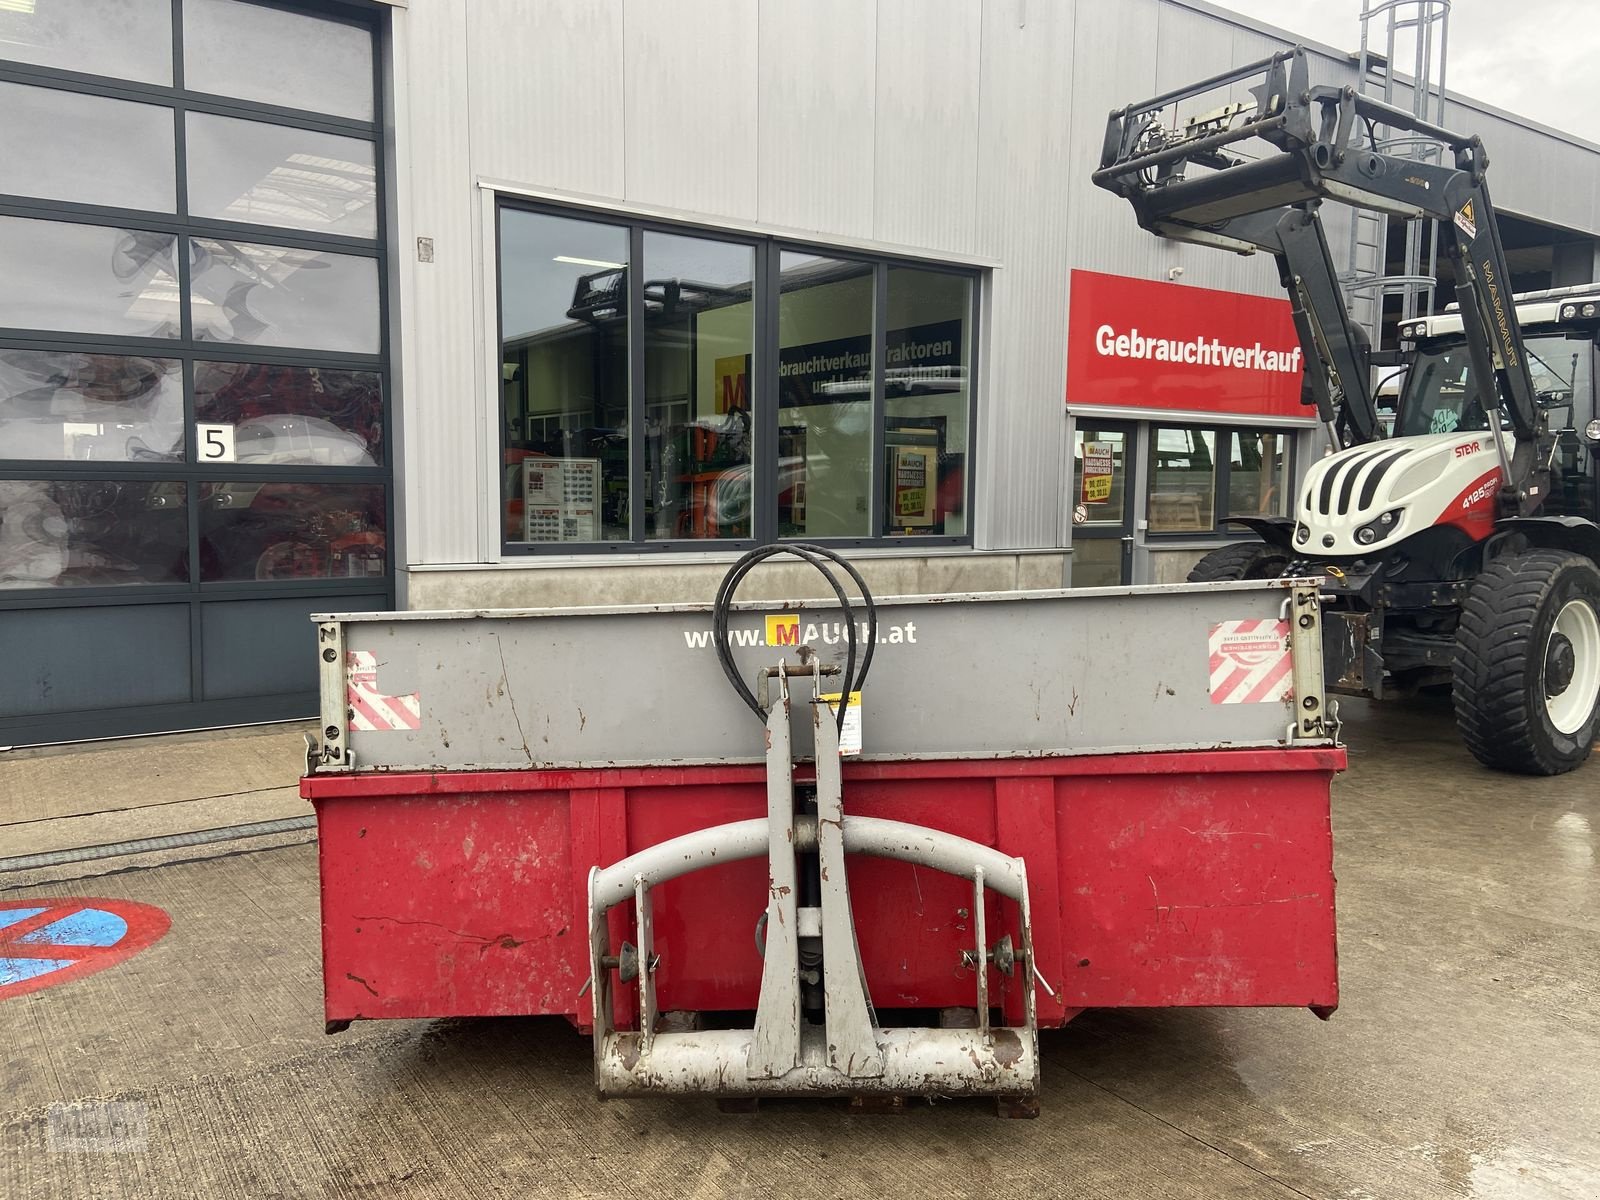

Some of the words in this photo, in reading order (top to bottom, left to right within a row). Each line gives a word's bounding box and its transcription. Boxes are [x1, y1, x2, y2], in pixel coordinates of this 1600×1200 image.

[1483, 260, 1517, 366] MAMMUT
[1095, 324, 1301, 373] Gebrauchtverkauf
[779, 351, 871, 376] brauchtverkau
[205, 429, 225, 458] 5
[1455, 441, 1480, 458] STEYR
[1462, 487, 1485, 509] 4125
